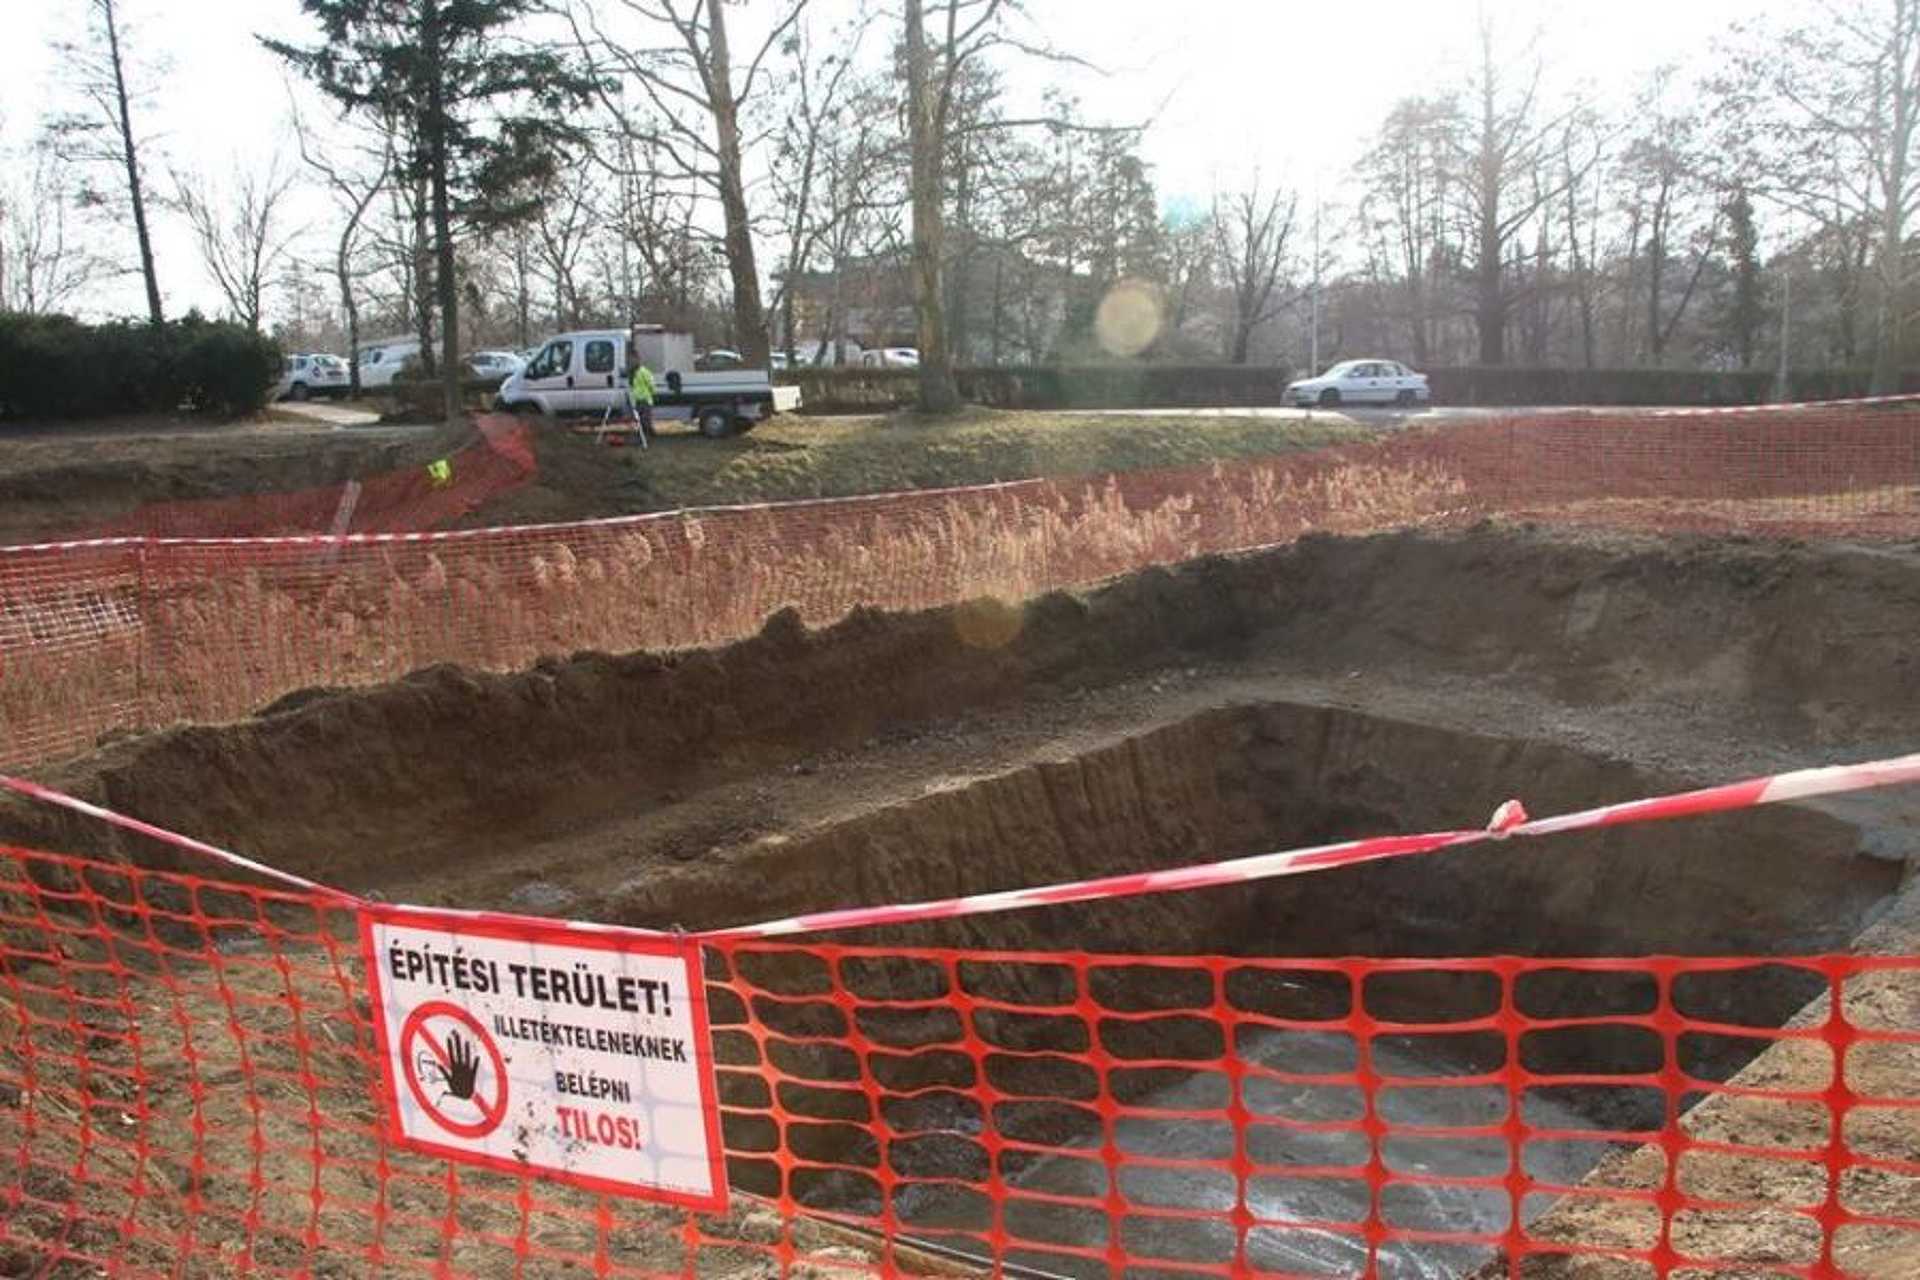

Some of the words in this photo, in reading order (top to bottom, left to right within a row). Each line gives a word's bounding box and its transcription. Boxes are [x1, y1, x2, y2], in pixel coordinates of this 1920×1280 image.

[389, 939, 500, 994] ÉPÍTÉSI
[509, 963, 672, 1016] TERÜLET!
[494, 1014, 687, 1062] ILLETÉKTELENEKNEK
[555, 1071, 631, 1103] BELÉPNI
[556, 1106, 642, 1151] TILOS!
